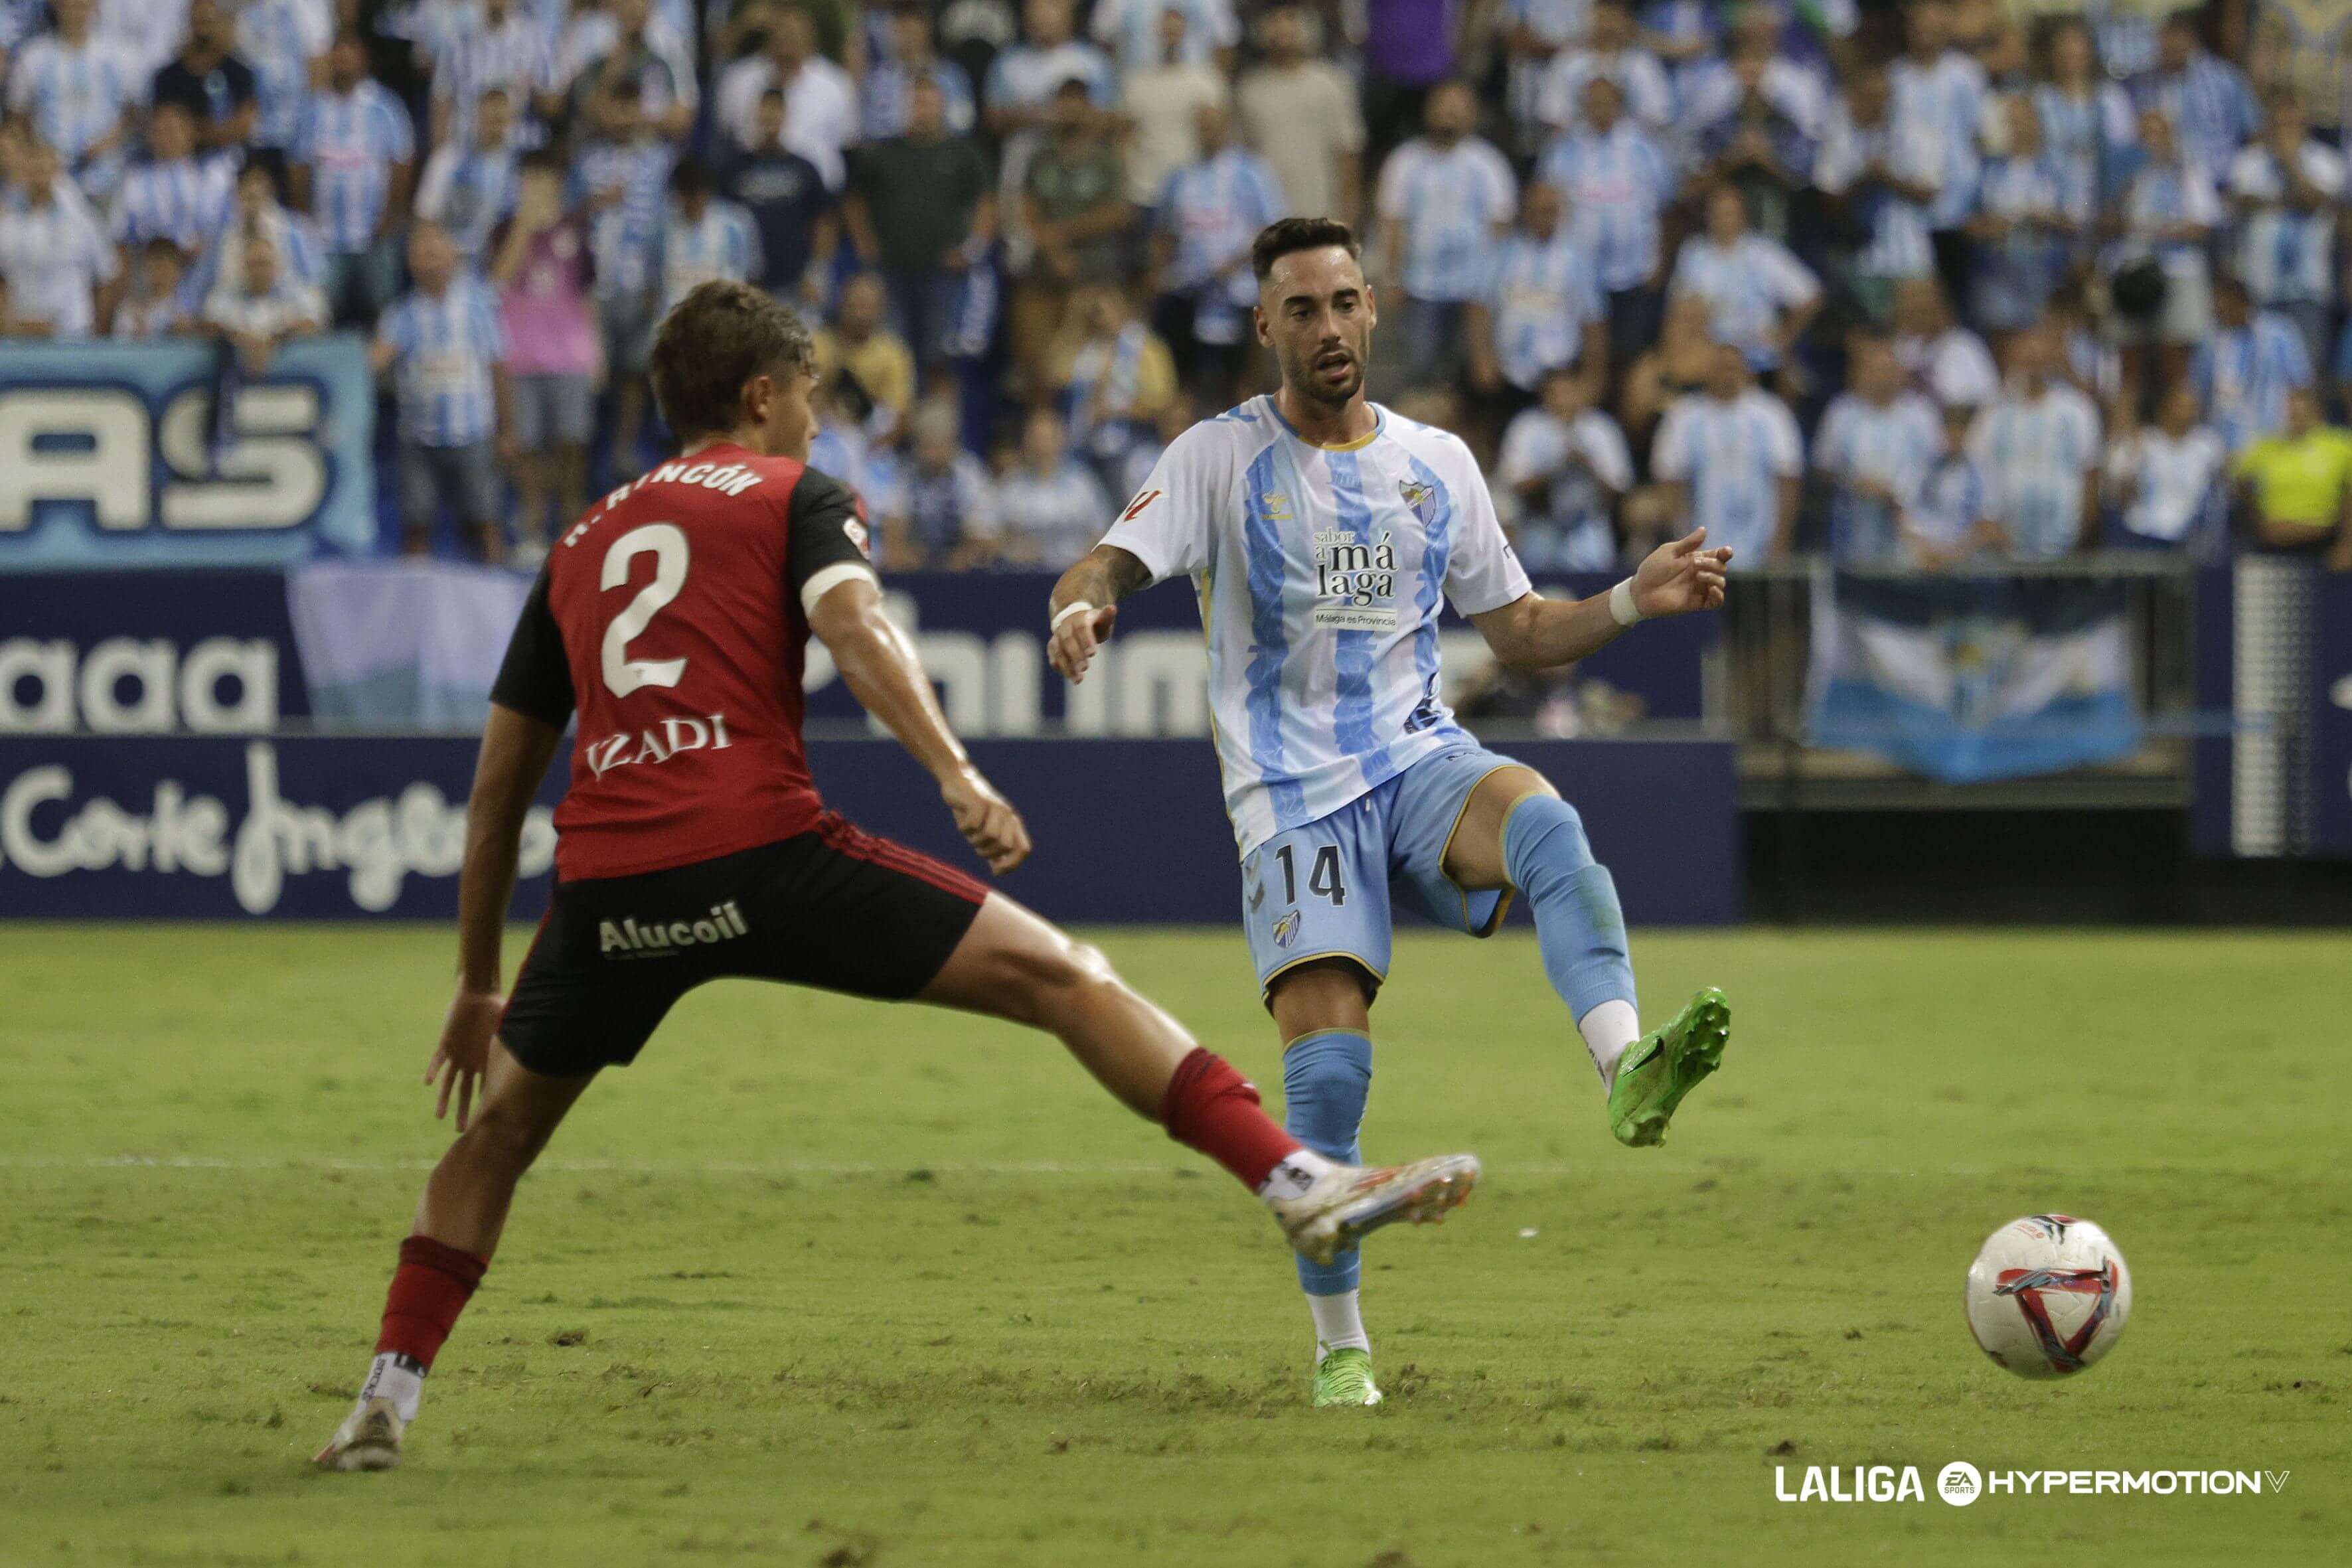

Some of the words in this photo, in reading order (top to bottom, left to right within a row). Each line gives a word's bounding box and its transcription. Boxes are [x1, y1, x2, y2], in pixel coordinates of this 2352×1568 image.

[0, 386, 327, 531] AS
[1313, 526, 1355, 544] sabor
[1328, 531, 1399, 572] má
[600, 522, 690, 699] 2
[1317, 564, 1395, 607] laga
[1358, 615, 1396, 626] Provincia
[586, 713, 734, 782] IZADI
[1, 763, 231, 878] Corte
[1274, 843, 1347, 907] 14
[599, 901, 747, 953] Alucoil
